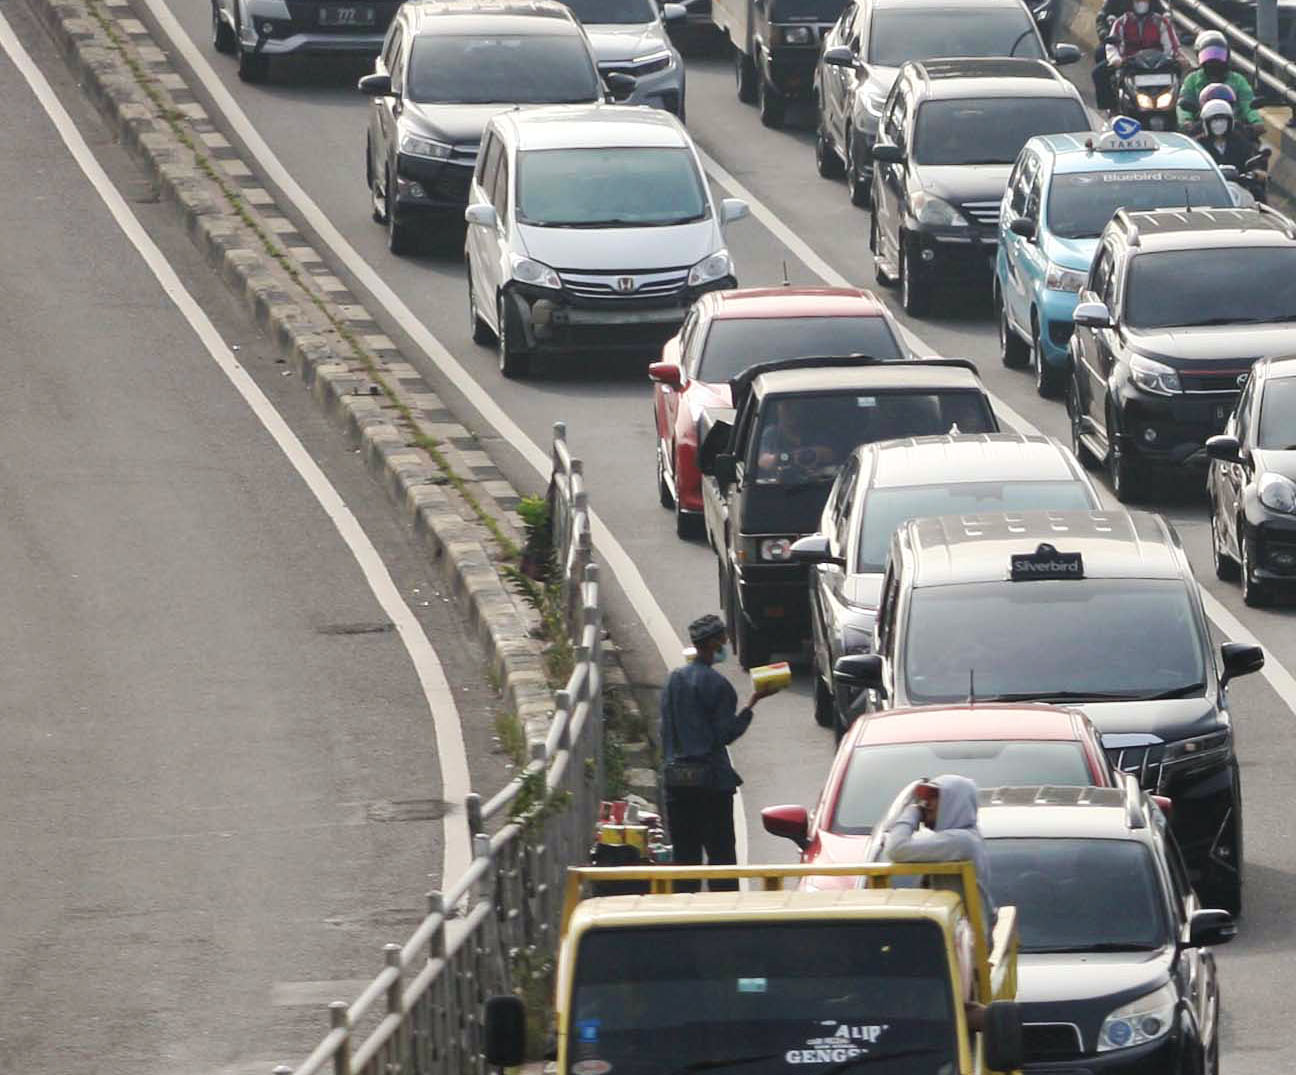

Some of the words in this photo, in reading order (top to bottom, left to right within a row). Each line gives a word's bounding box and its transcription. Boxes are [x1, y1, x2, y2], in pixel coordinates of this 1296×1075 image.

[1109, 139, 1149, 150] TAKSI
[1103, 172, 1162, 182] Bluebird
[1164, 173, 1202, 183] Group
[1015, 559, 1078, 573] Silverbird
